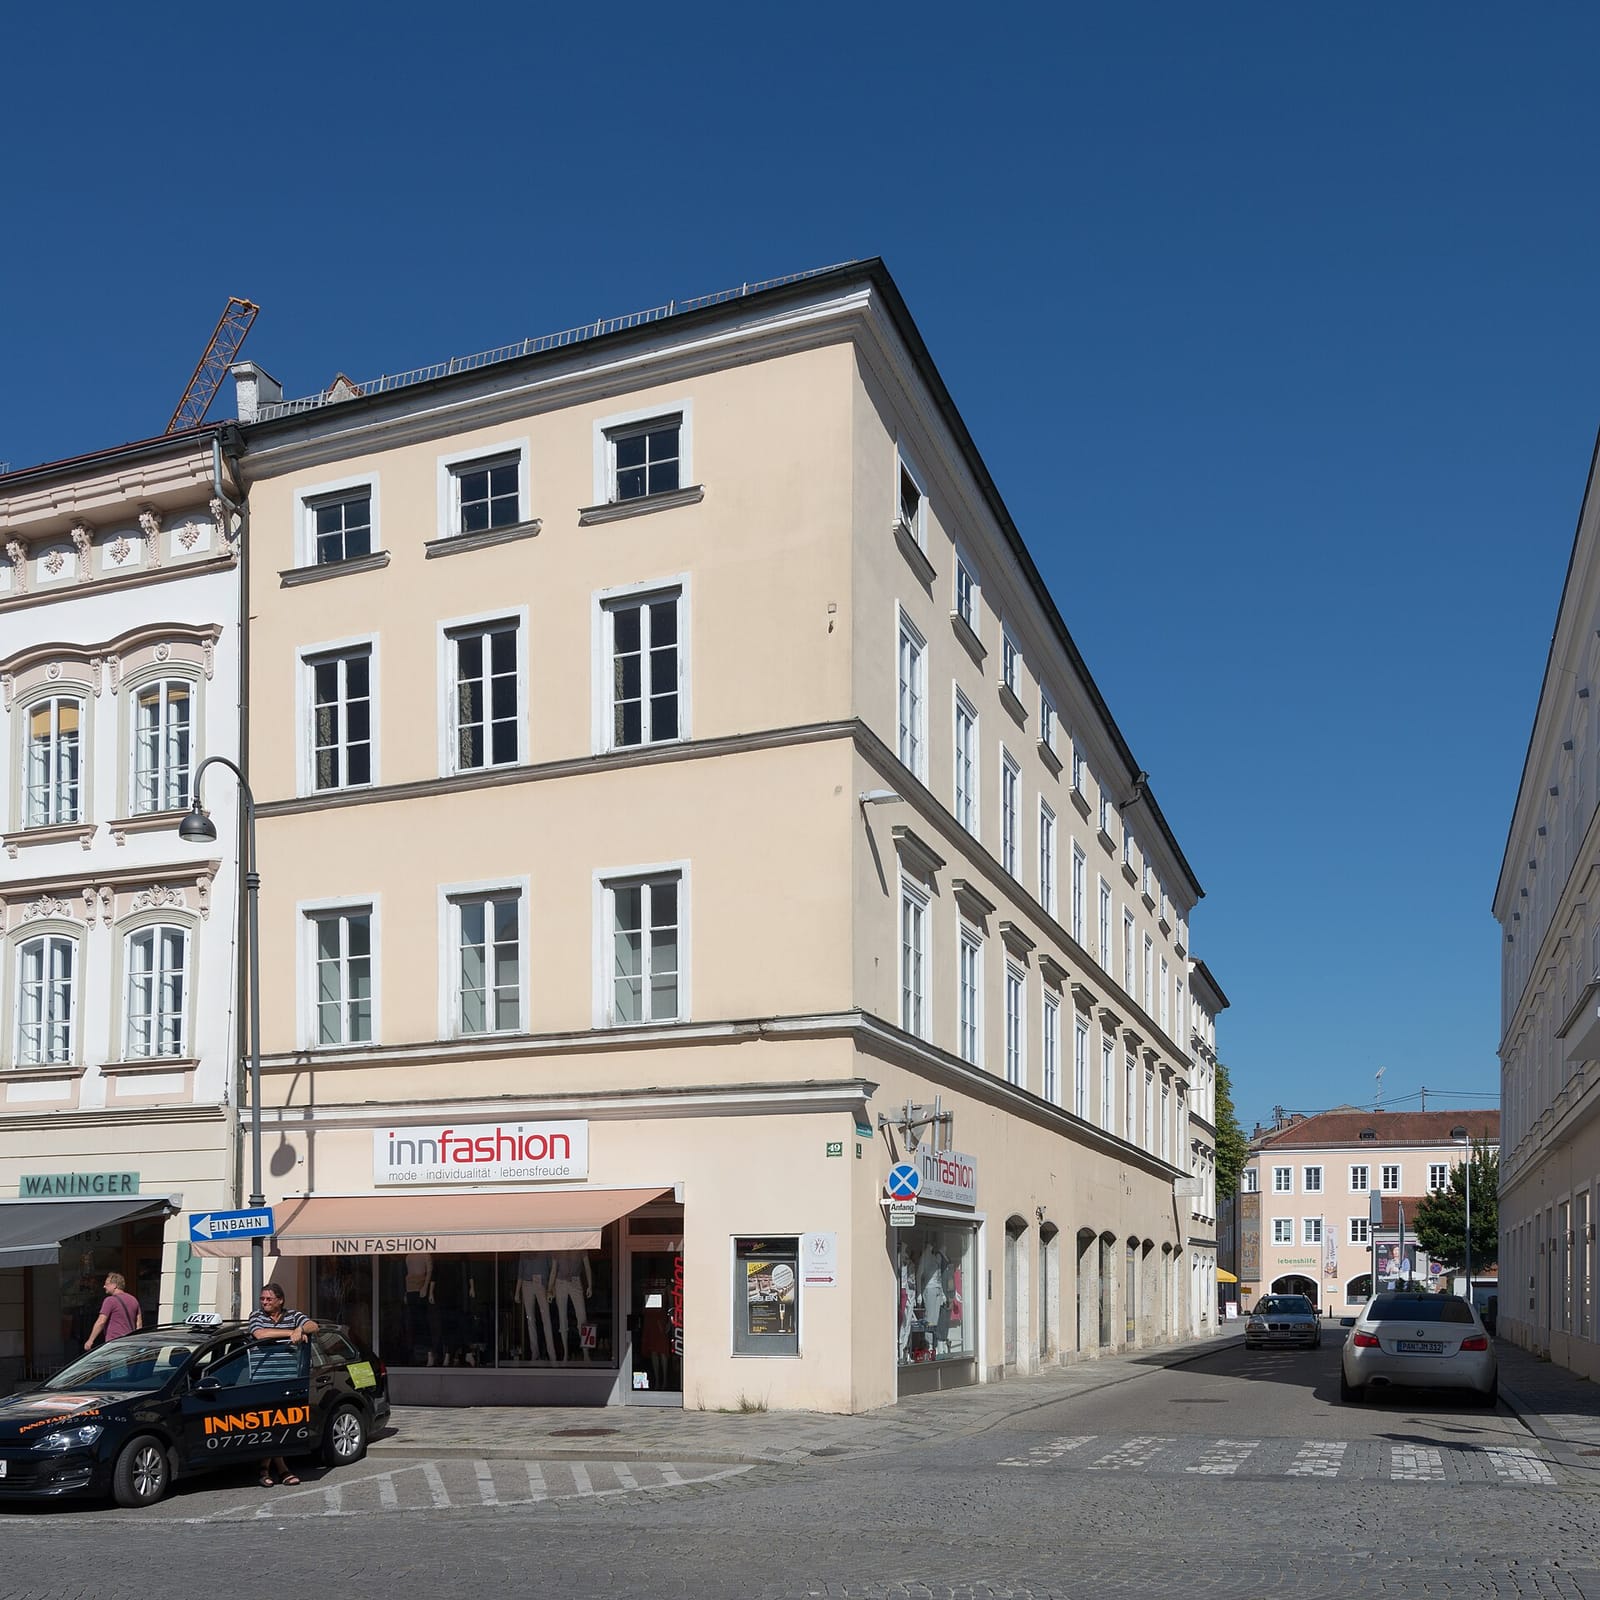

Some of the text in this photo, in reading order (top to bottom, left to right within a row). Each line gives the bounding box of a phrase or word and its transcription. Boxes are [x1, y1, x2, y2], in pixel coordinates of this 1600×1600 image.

[389, 1126, 570, 1166] innfashion
[828, 1143, 841, 1152] 49
[388, 1165, 570, 1181] mode individualität lebensfreude
[922, 1146, 974, 1189] innfashion
[891, 1203, 914, 1212] Anfang
[210, 1217, 263, 1232] EINBAHN
[331, 1238, 437, 1253] INN FASHION
[1277, 1257, 1317, 1265] lebenshilfe
[187, 1314, 216, 1323] TAXI
[206, 1431, 273, 1449] 07722
